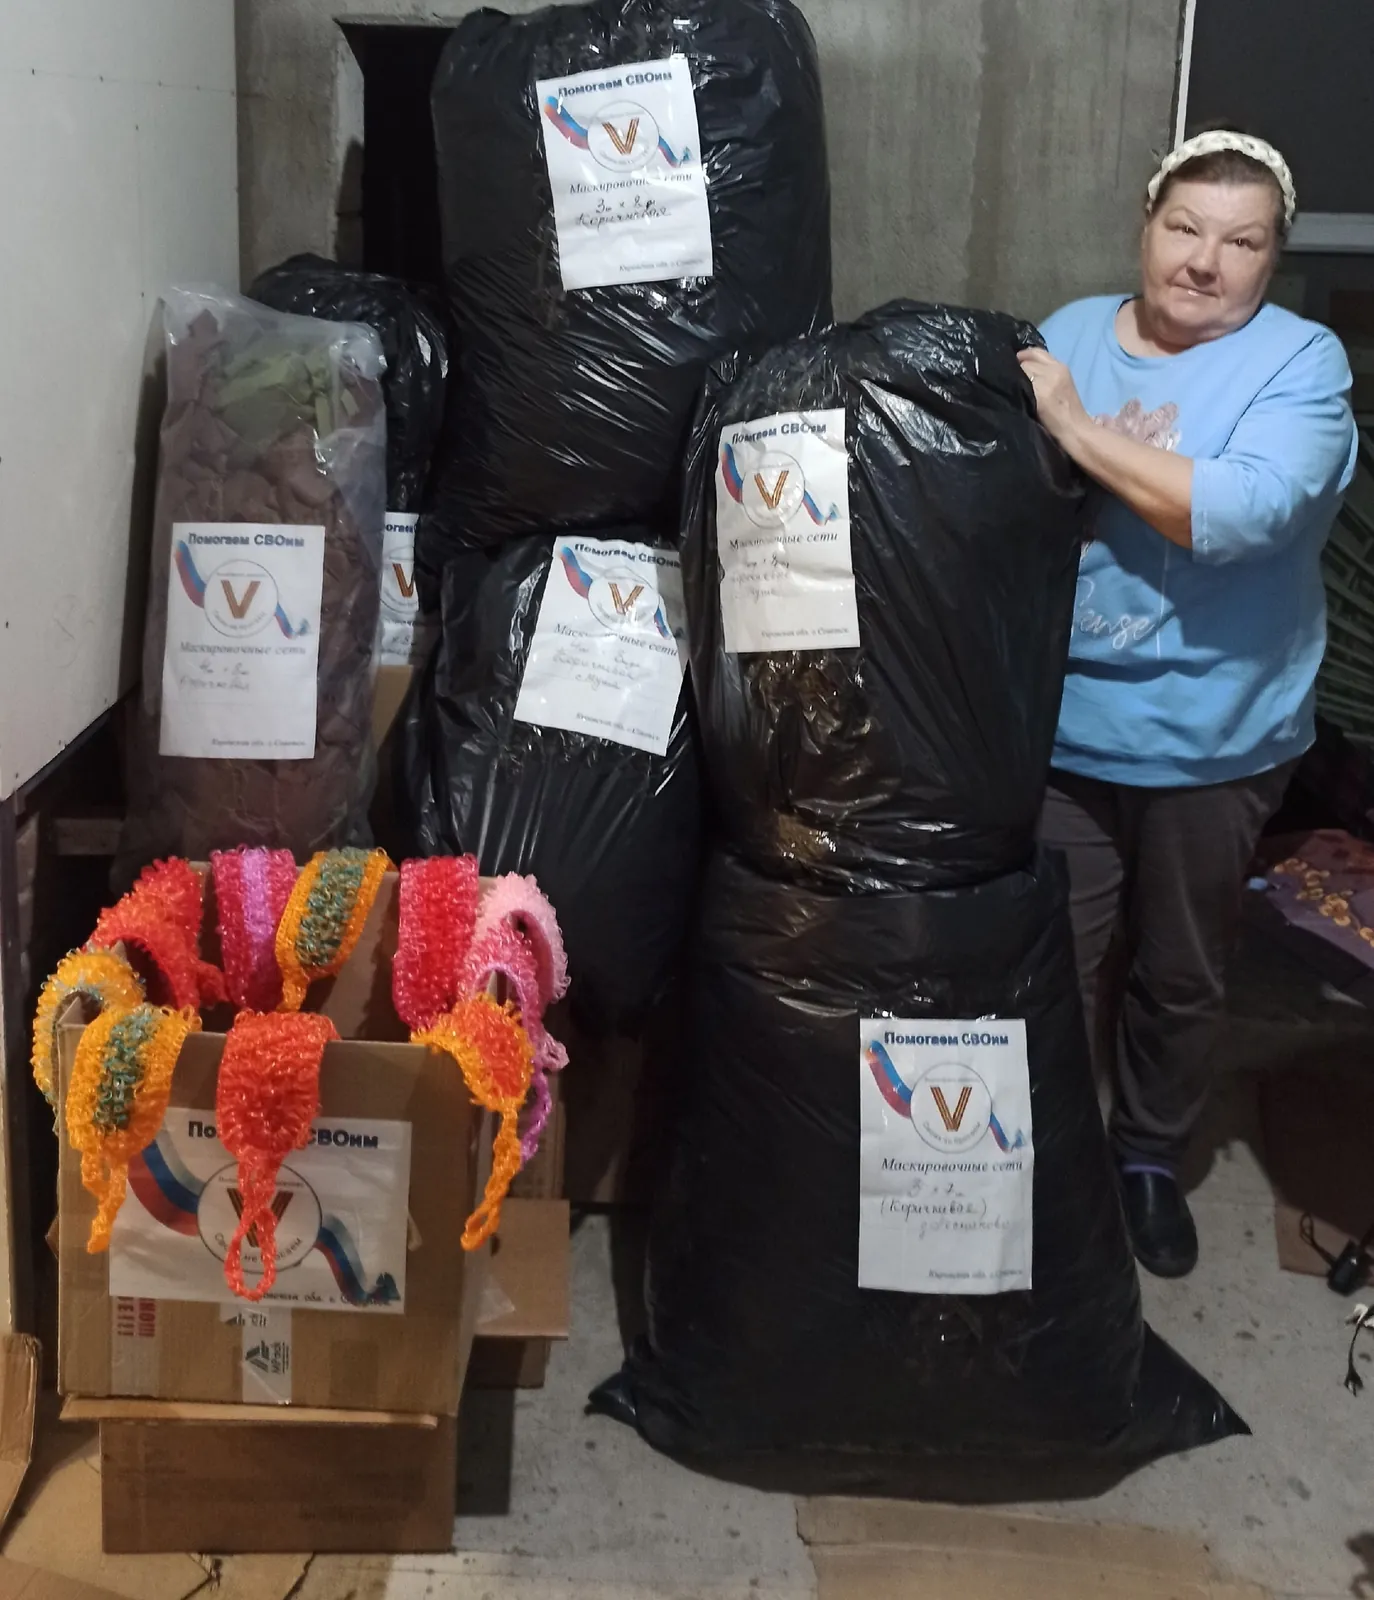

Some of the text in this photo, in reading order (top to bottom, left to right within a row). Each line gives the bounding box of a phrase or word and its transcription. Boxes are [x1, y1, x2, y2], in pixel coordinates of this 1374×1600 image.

[558, 71, 673, 98] Помогаем СВОим
[187, 532, 305, 547] Помогаем СВОим
[806, 531, 838, 542] сети
[574, 543, 636, 562] Помогаем
[220, 579, 261, 620] V
[648, 643, 678, 656] сети
[884, 1031, 1009, 1046] Помогаем СВОим
[930, 1085, 973, 1132] V
[881, 1157, 1023, 1175] Маскировочные сети
